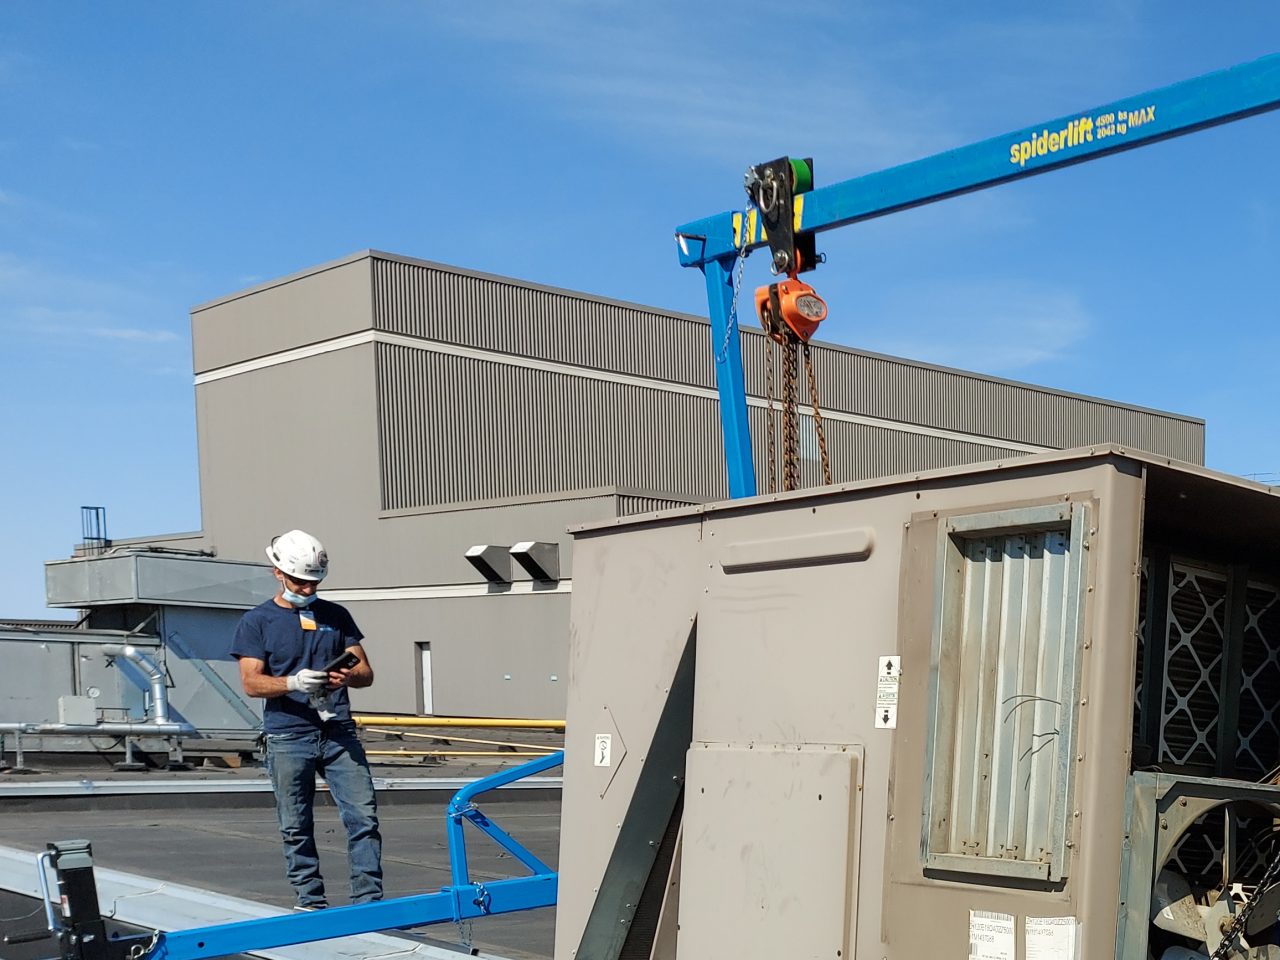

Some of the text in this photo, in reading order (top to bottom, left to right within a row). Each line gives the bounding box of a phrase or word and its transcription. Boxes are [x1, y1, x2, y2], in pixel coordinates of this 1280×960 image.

[1096, 113, 1114, 126] 4500
[1129, 105, 1155, 128] MAX
[1097, 123, 1126, 139] 2042 kg
[1010, 117, 1093, 166] spiderlift
